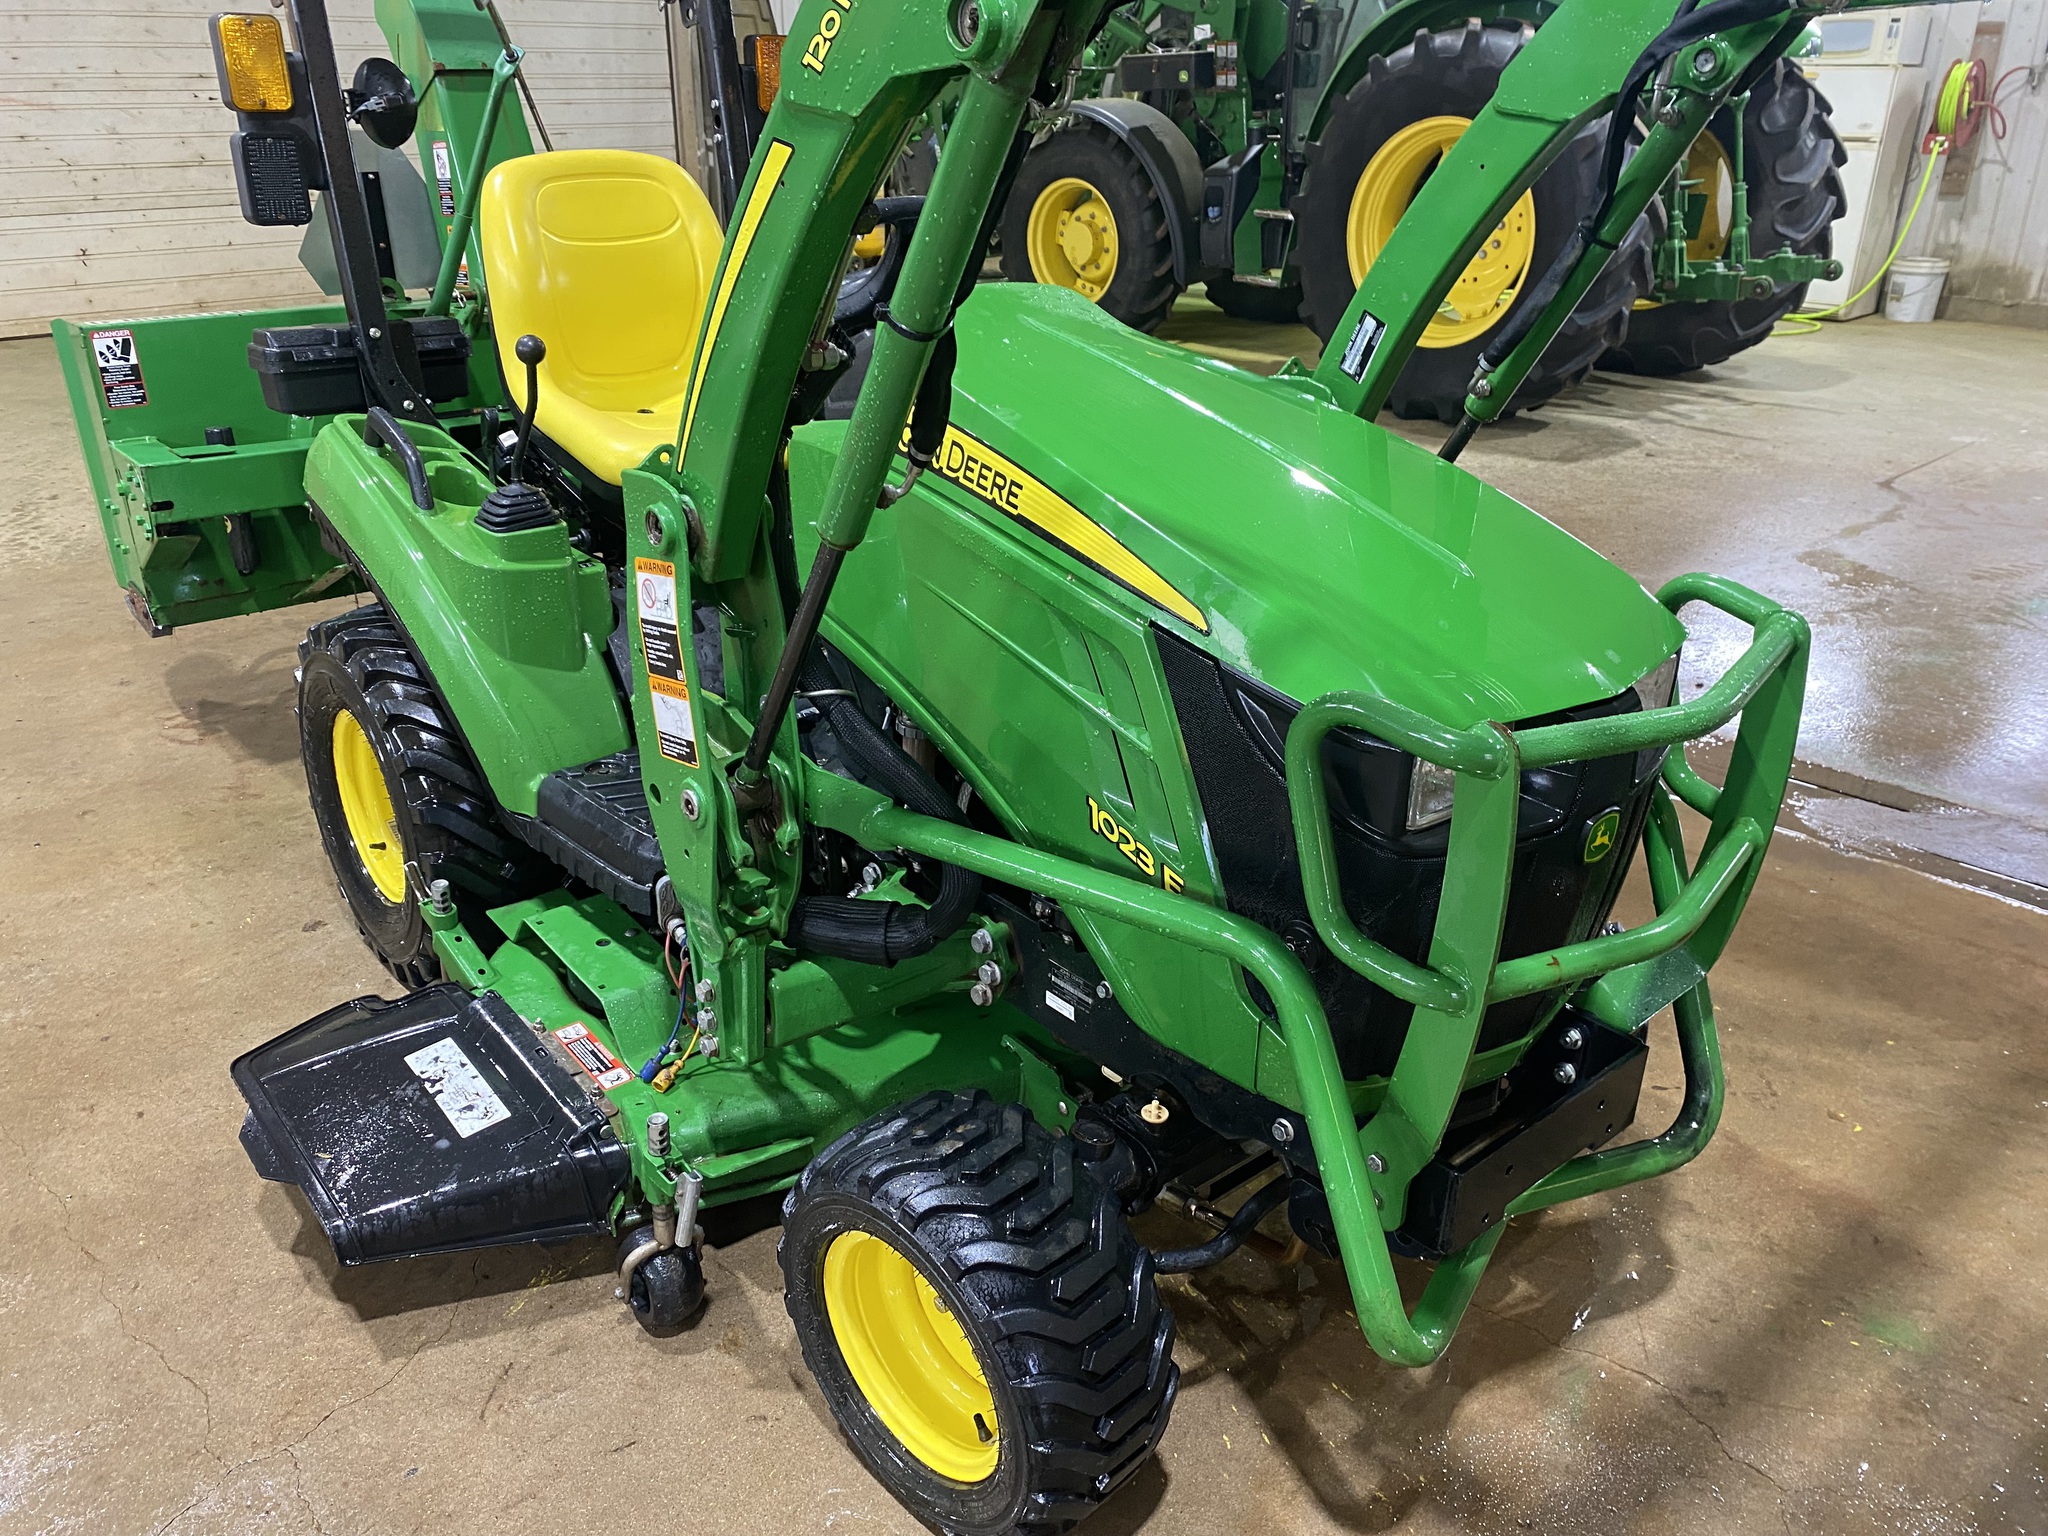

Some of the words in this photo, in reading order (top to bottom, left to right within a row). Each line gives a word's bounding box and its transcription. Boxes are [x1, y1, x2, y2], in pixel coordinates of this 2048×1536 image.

[99, 329, 131, 338] DANGER
[945, 439, 1024, 511] DEERE
[642, 561, 673, 575] WARNING
[656, 681, 687, 698] WARNING
[1086, 795, 1155, 876] 1023
